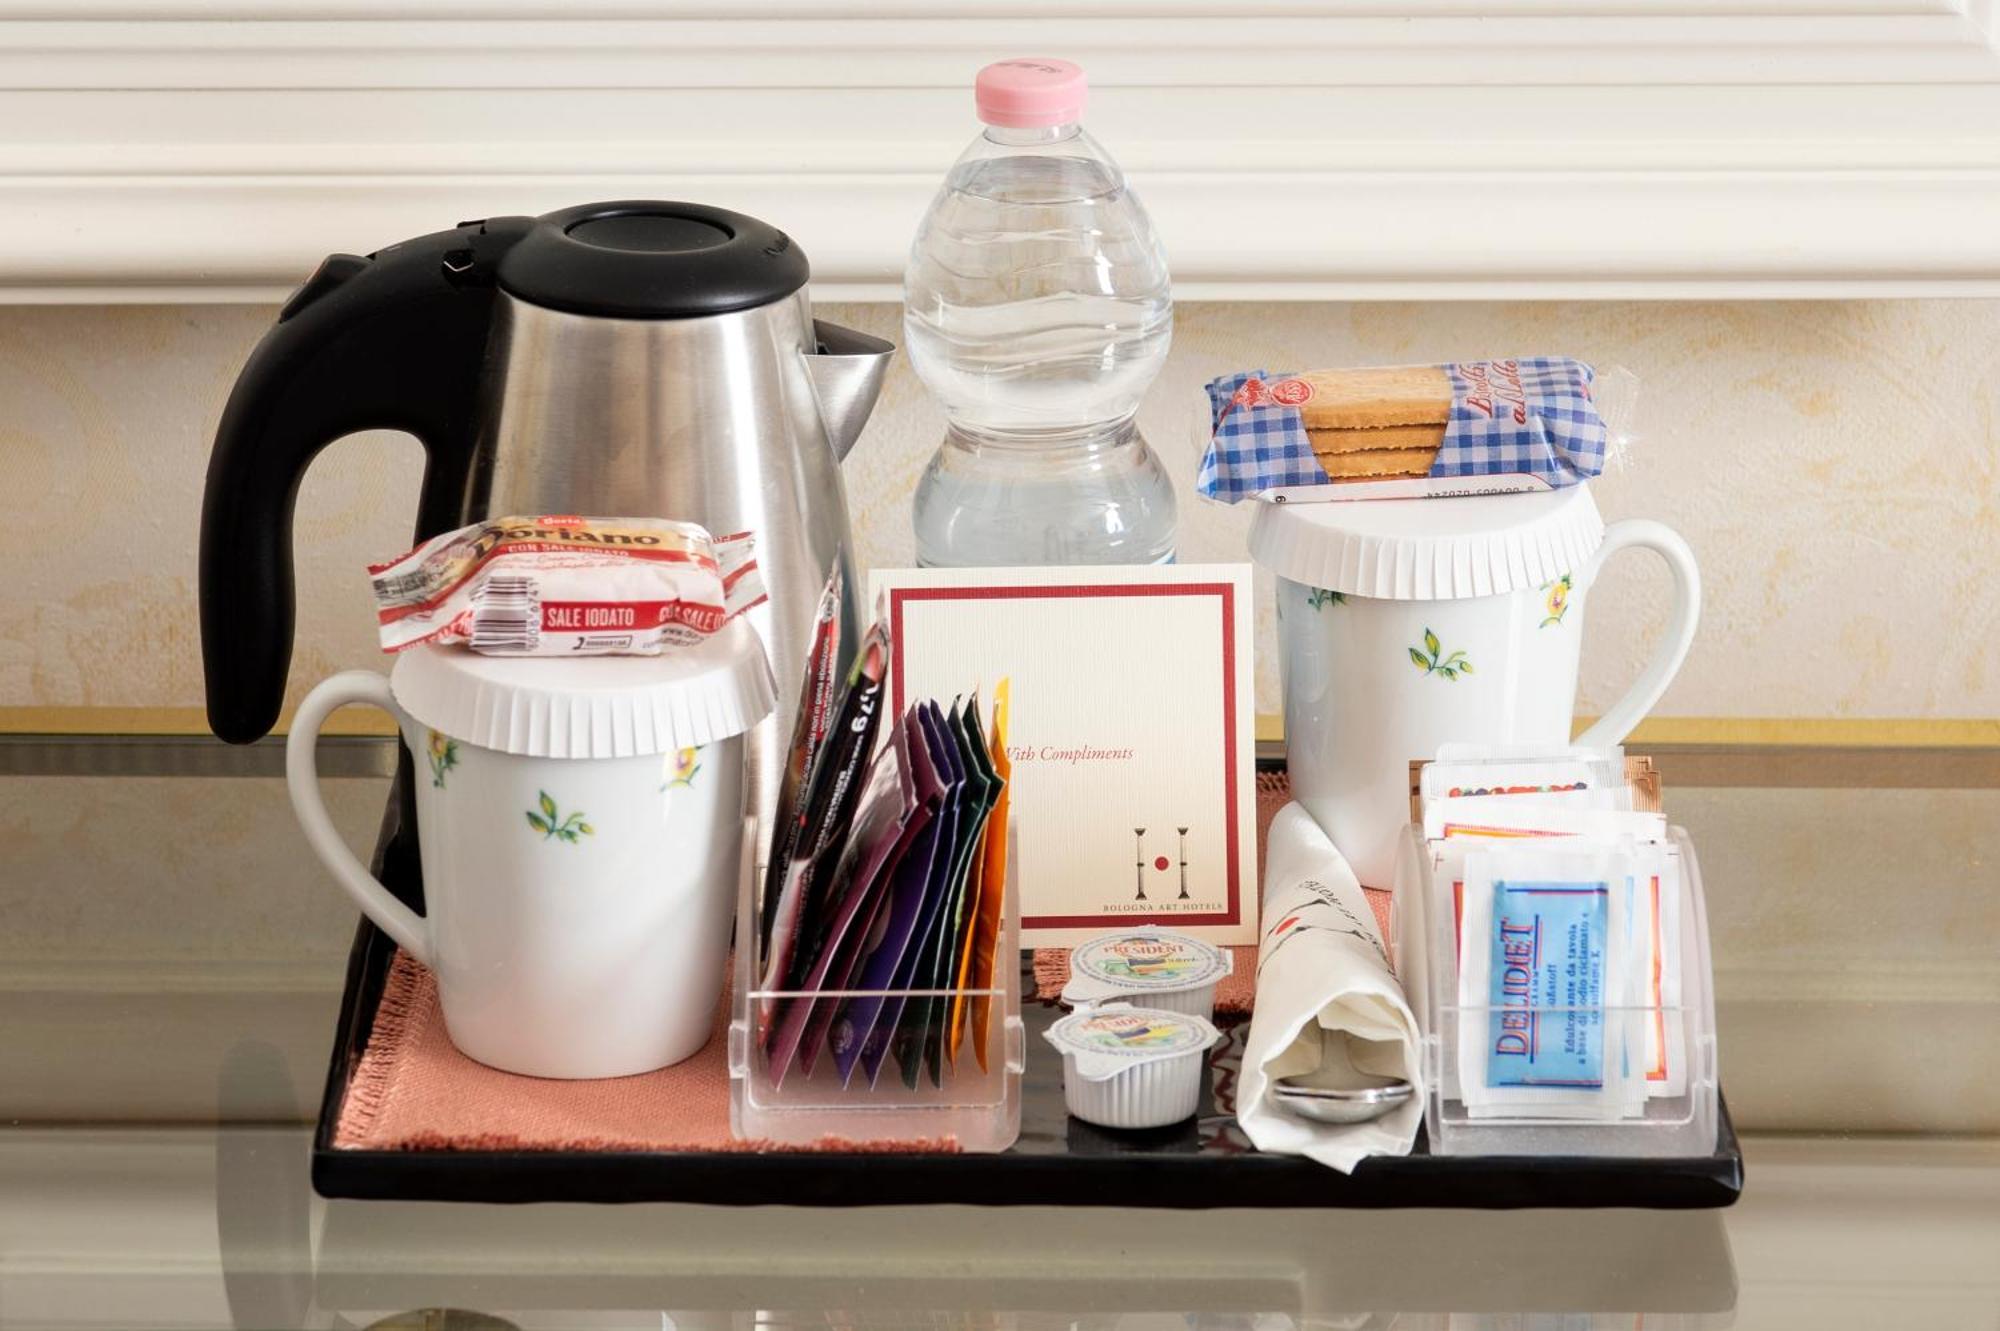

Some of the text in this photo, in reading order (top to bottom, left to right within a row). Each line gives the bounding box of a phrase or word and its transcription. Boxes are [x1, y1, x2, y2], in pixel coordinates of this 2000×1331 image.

[474, 525, 660, 558] Doriano
[541, 543, 573, 553] SALE
[547, 607, 635, 628] SALE IODATO
[682, 607, 713, 631] SALE
[1040, 745, 1135, 765] Compliments
[1103, 902, 1223, 912] BOLOGNA ART HOTELS
[1567, 924, 1577, 959] tavola
[1578, 922, 1588, 975] ciclamato
[1566, 964, 1575, 977] da
[1495, 917, 1533, 1056] DELIDIET
[1578, 979, 1588, 1008] odio
